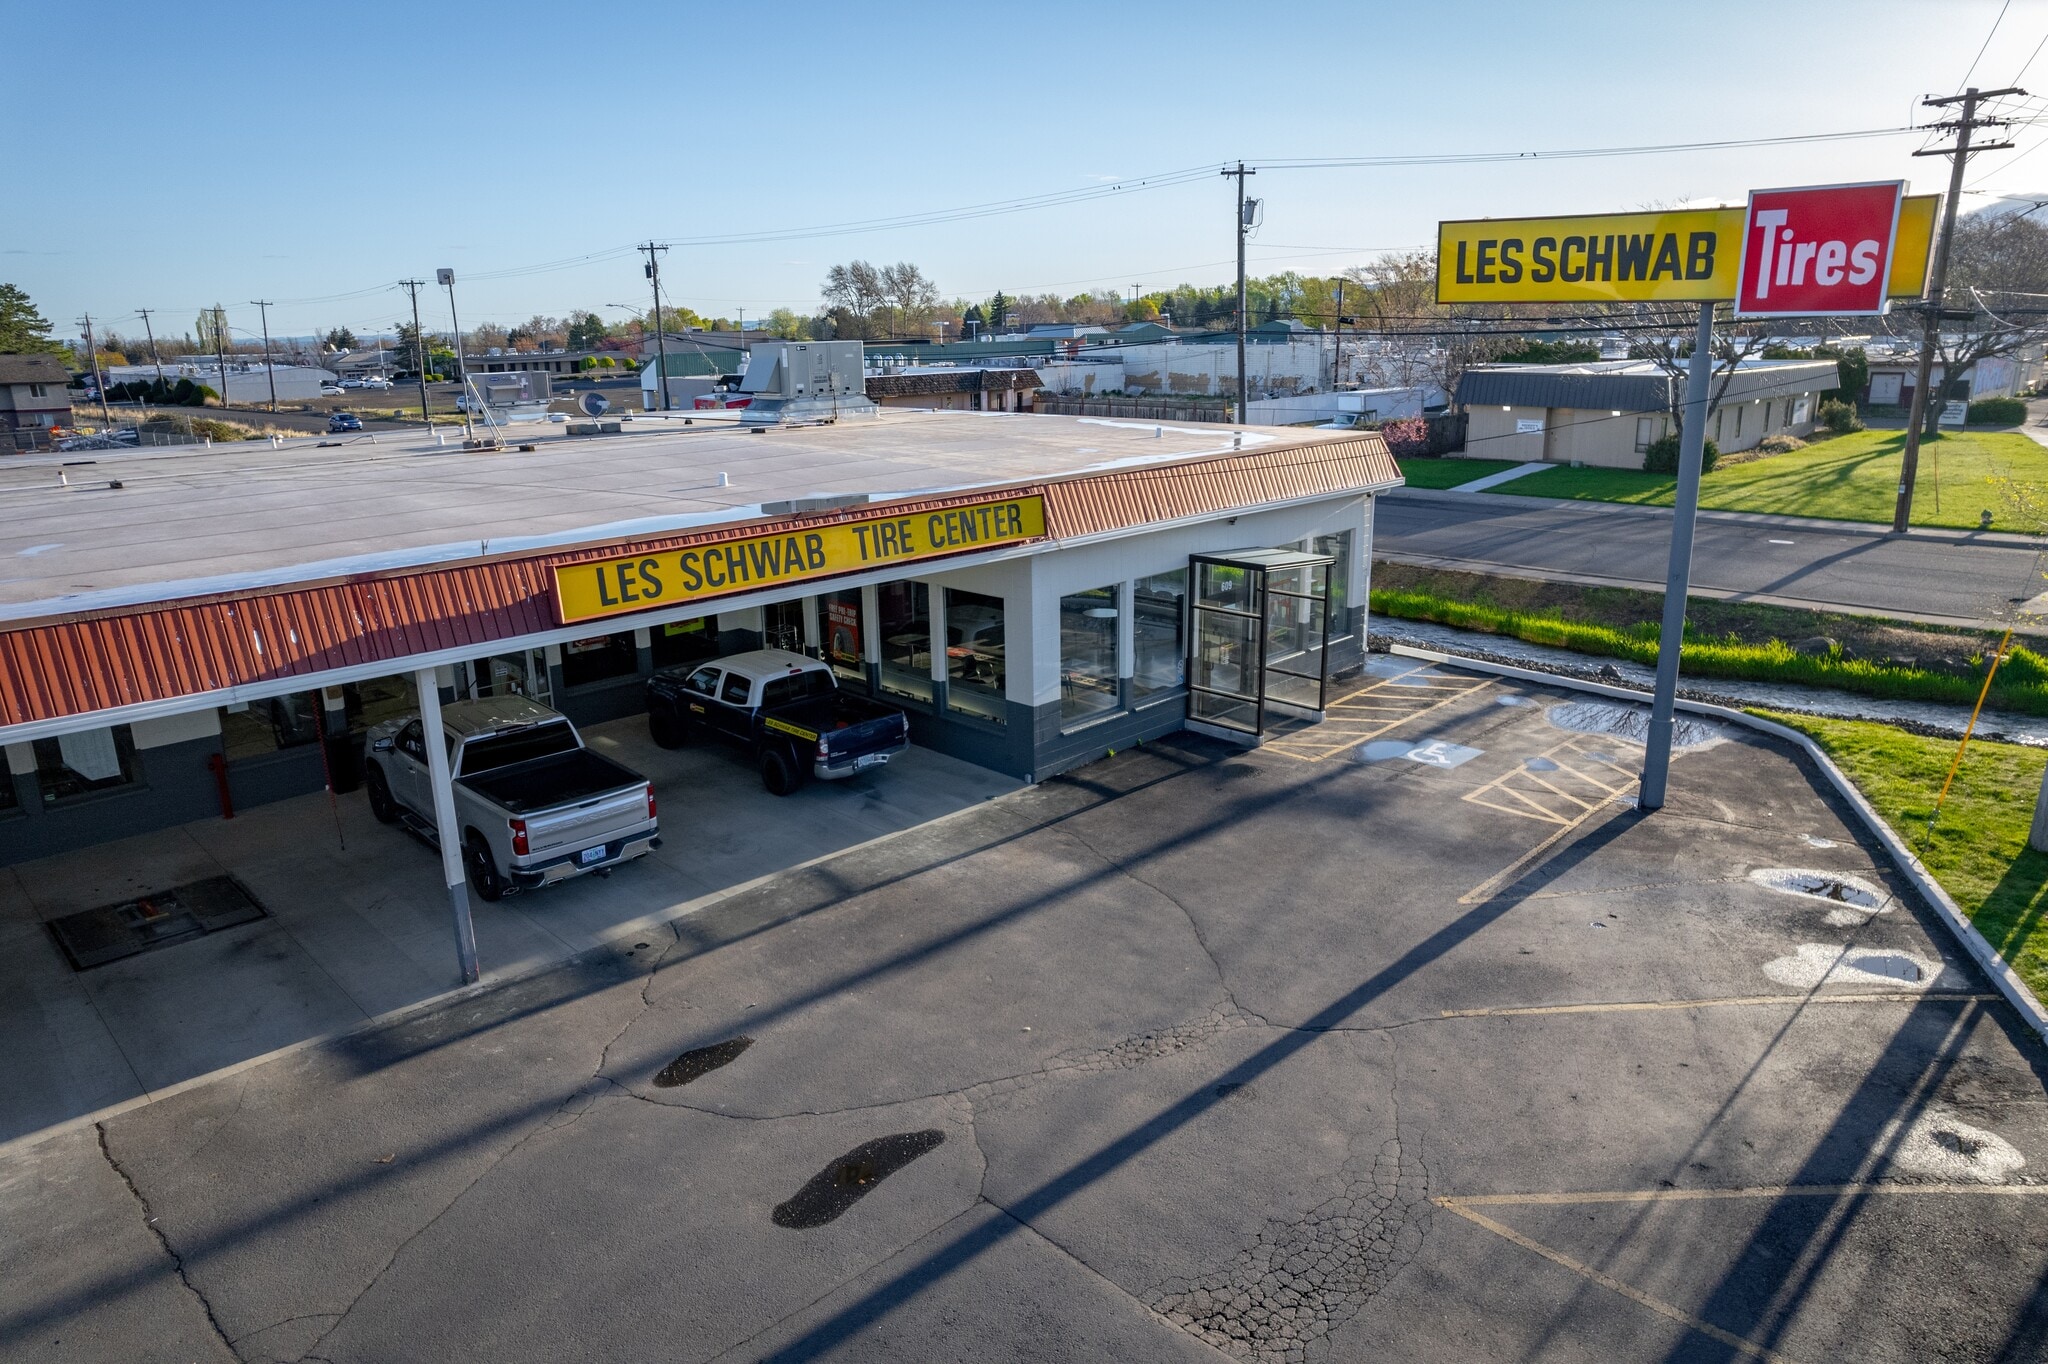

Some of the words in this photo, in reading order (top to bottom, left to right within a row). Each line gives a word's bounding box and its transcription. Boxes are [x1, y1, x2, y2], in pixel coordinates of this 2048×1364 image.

[1456, 239, 1523, 284] LES
[1531, 232, 1717, 283] SCHWAB
[1755, 209, 1880, 299] Tires
[596, 559, 663, 607] LES
[680, 533, 826, 591] SCHWAB
[852, 520, 914, 561] TIRE
[928, 504, 1023, 548] CENTER
[1221, 581, 1233, 592] 609
